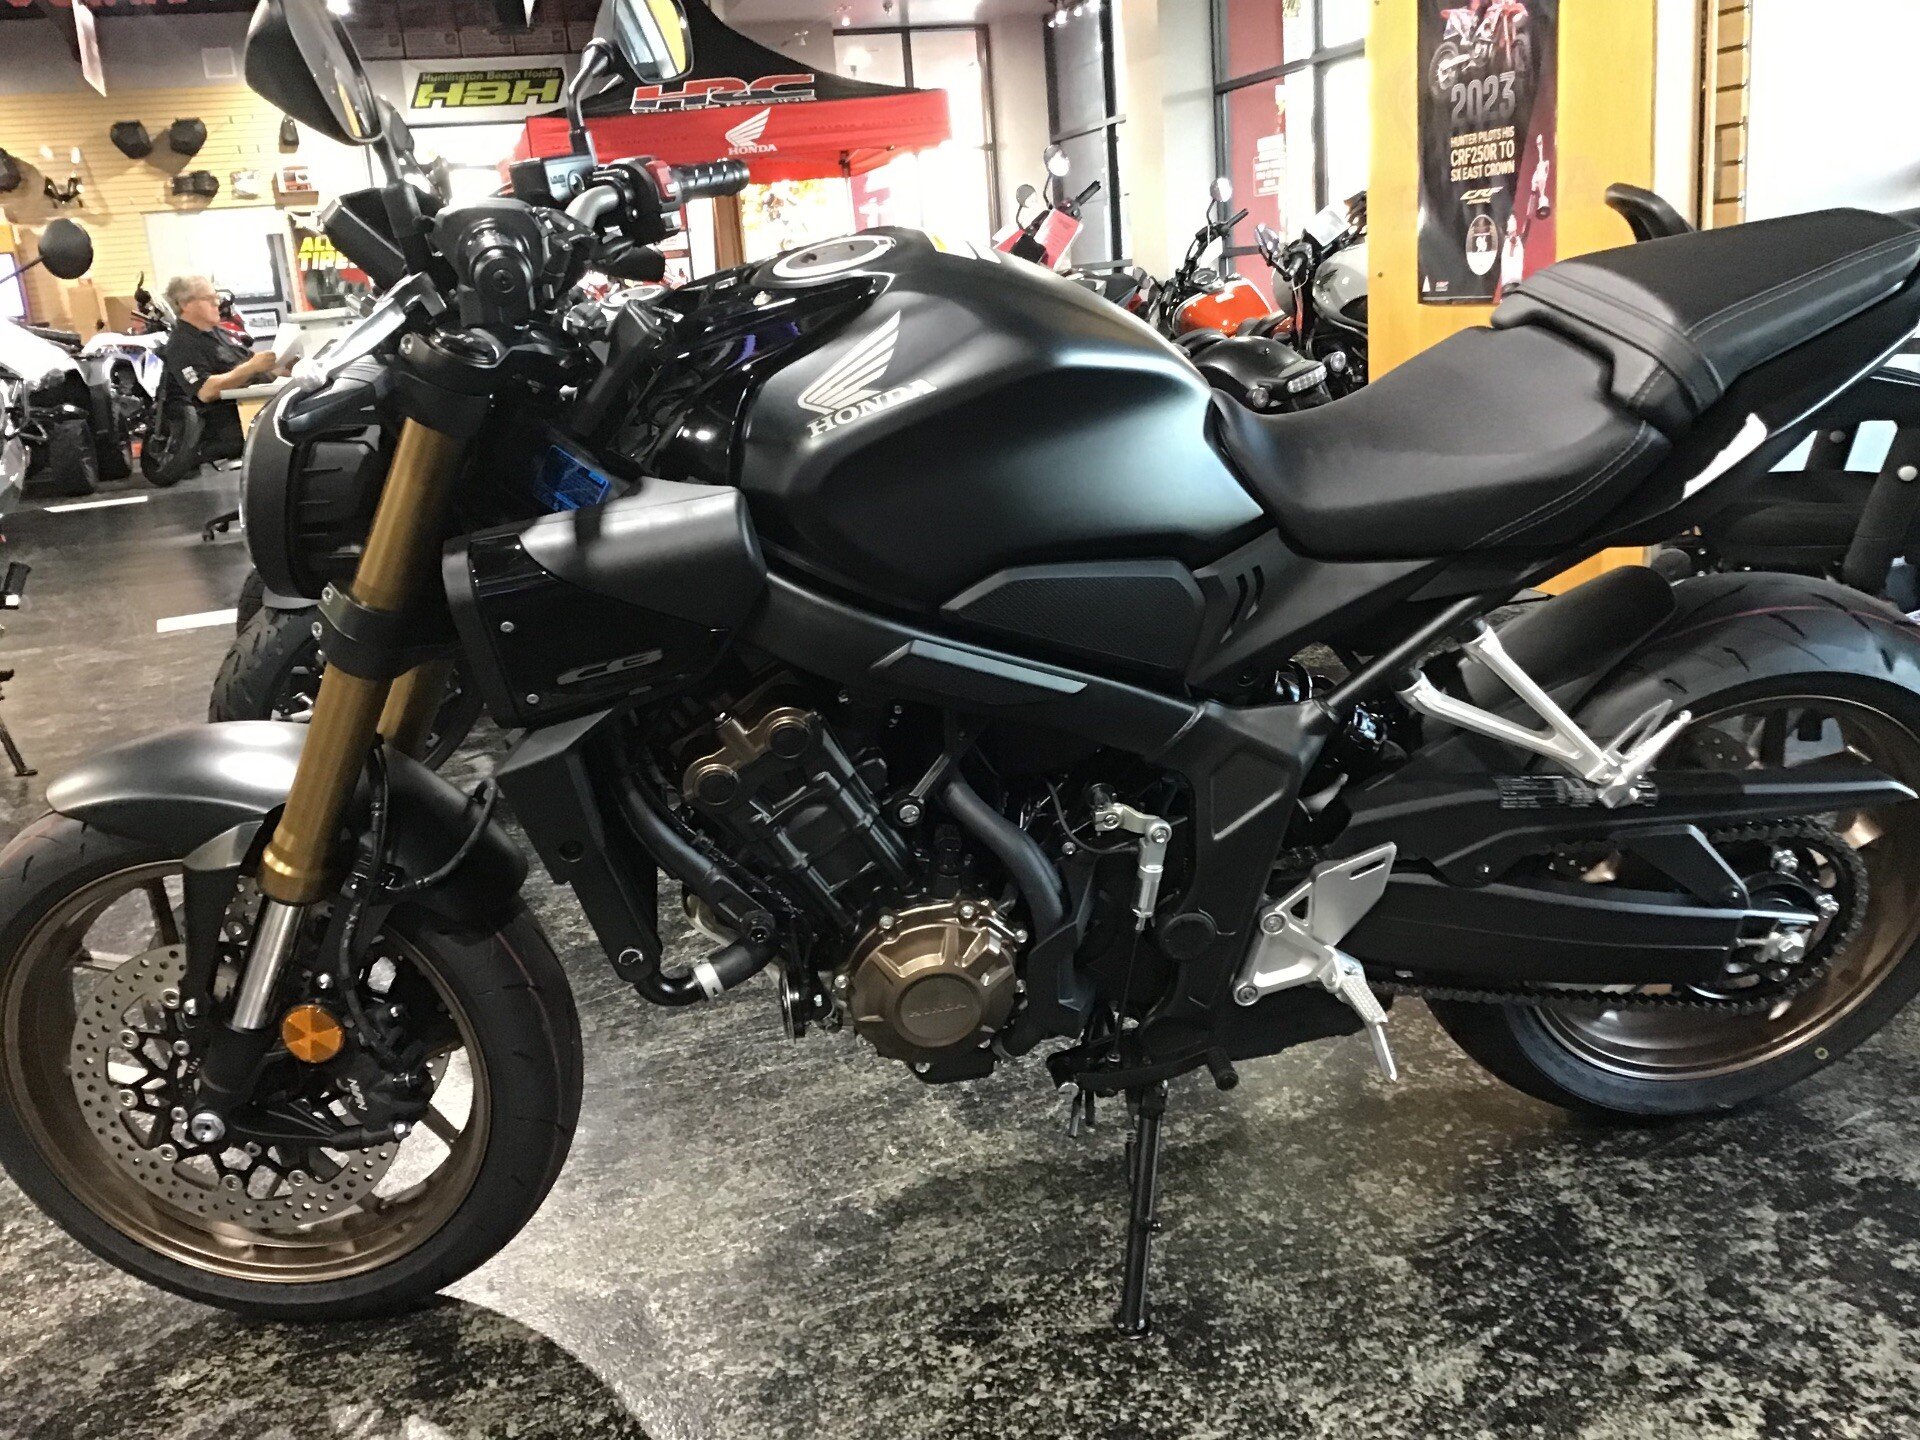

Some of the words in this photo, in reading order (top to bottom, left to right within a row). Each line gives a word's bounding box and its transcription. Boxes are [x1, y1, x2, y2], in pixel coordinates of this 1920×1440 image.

[422, 71, 484, 83] Huntington
[486, 70, 521, 80] Beach
[523, 68, 559, 79] Honda
[413, 78, 562, 109] HBH
[631, 73, 815, 110] HRC
[1450, 70, 1516, 124] 2023
[728, 143, 778, 155] HONDA
[1450, 133, 1477, 148] HUNTER
[1478, 128, 1501, 142] PILOTS
[1450, 143, 1497, 167] CRF250R
[1499, 139, 1515, 159] TO
[1450, 168, 1461, 182] SX
[1462, 165, 1483, 180] EAST
[1484, 160, 1515, 177] CROWN
[807, 379, 938, 438] HONDA
